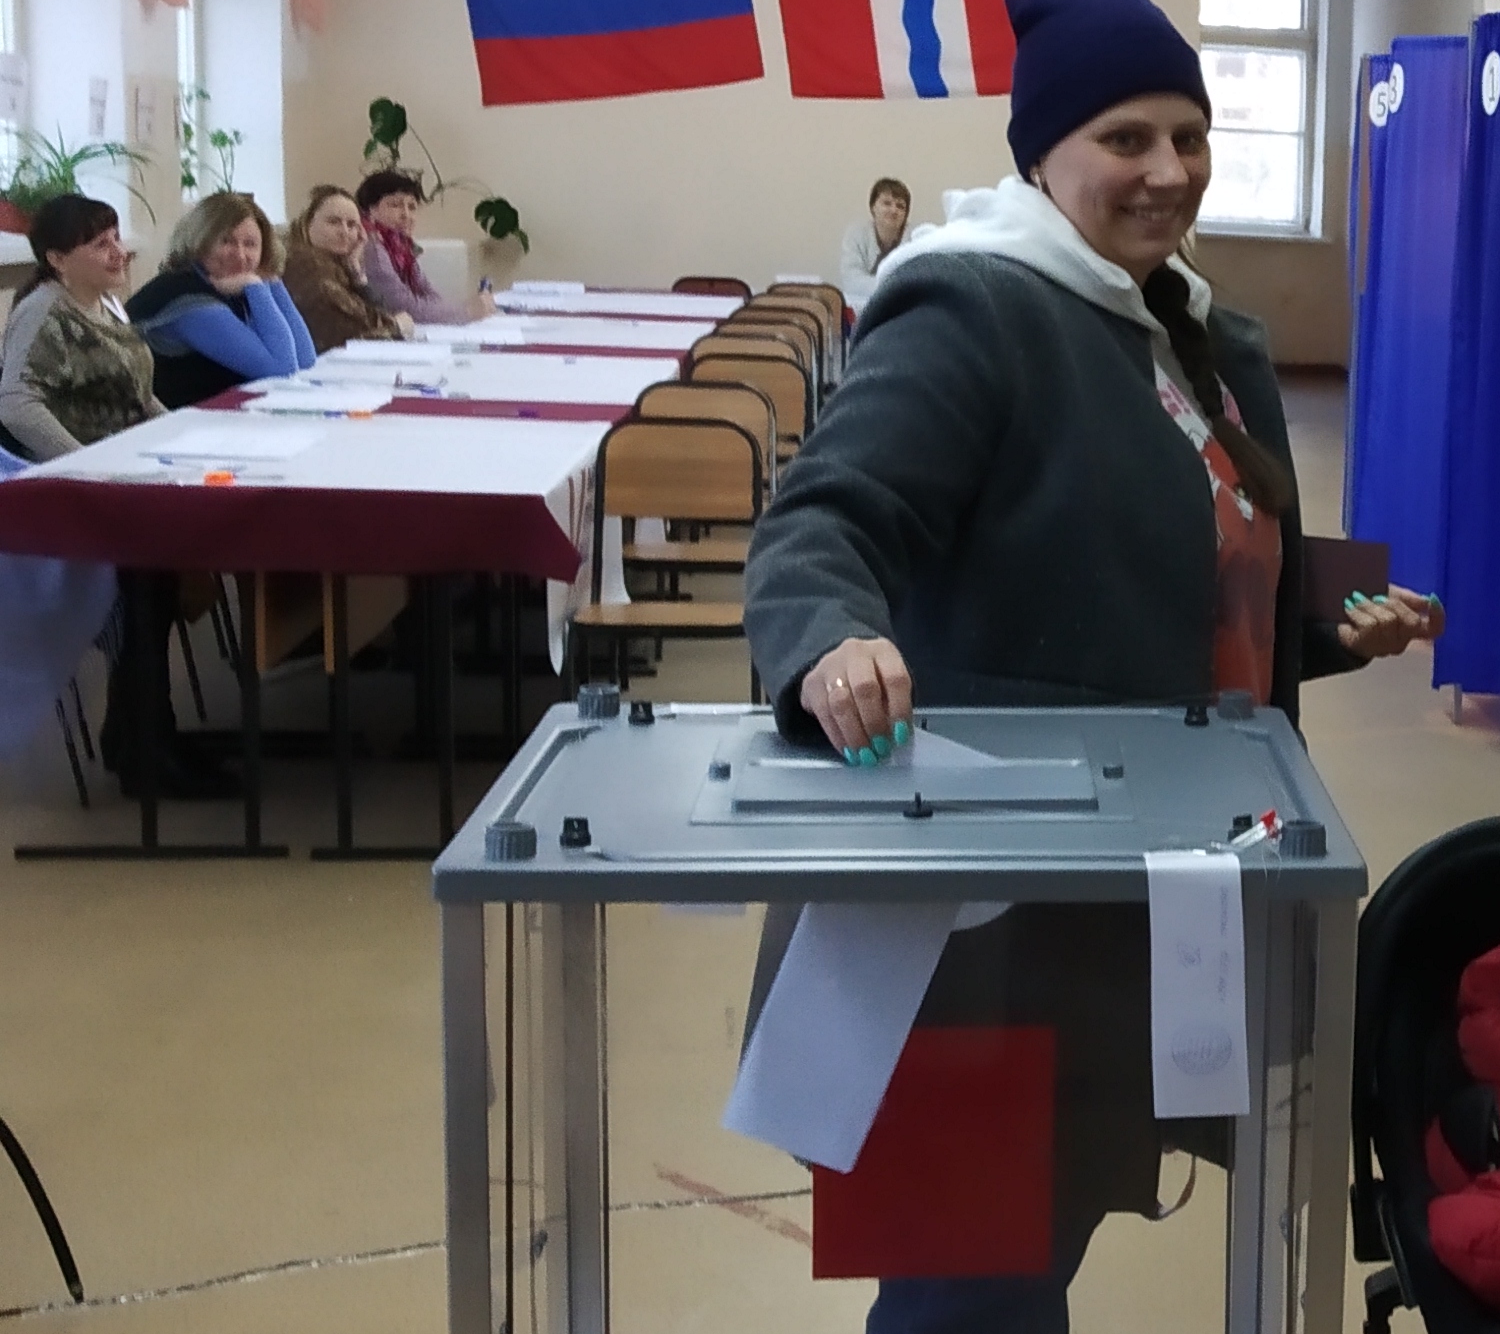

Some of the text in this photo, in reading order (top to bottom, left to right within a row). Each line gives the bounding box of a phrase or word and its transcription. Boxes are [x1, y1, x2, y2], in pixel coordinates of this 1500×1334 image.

[1389, 75, 1398, 105] 3
[1488, 67, 1496, 102] 1
[1376, 92, 1387, 118] 5
